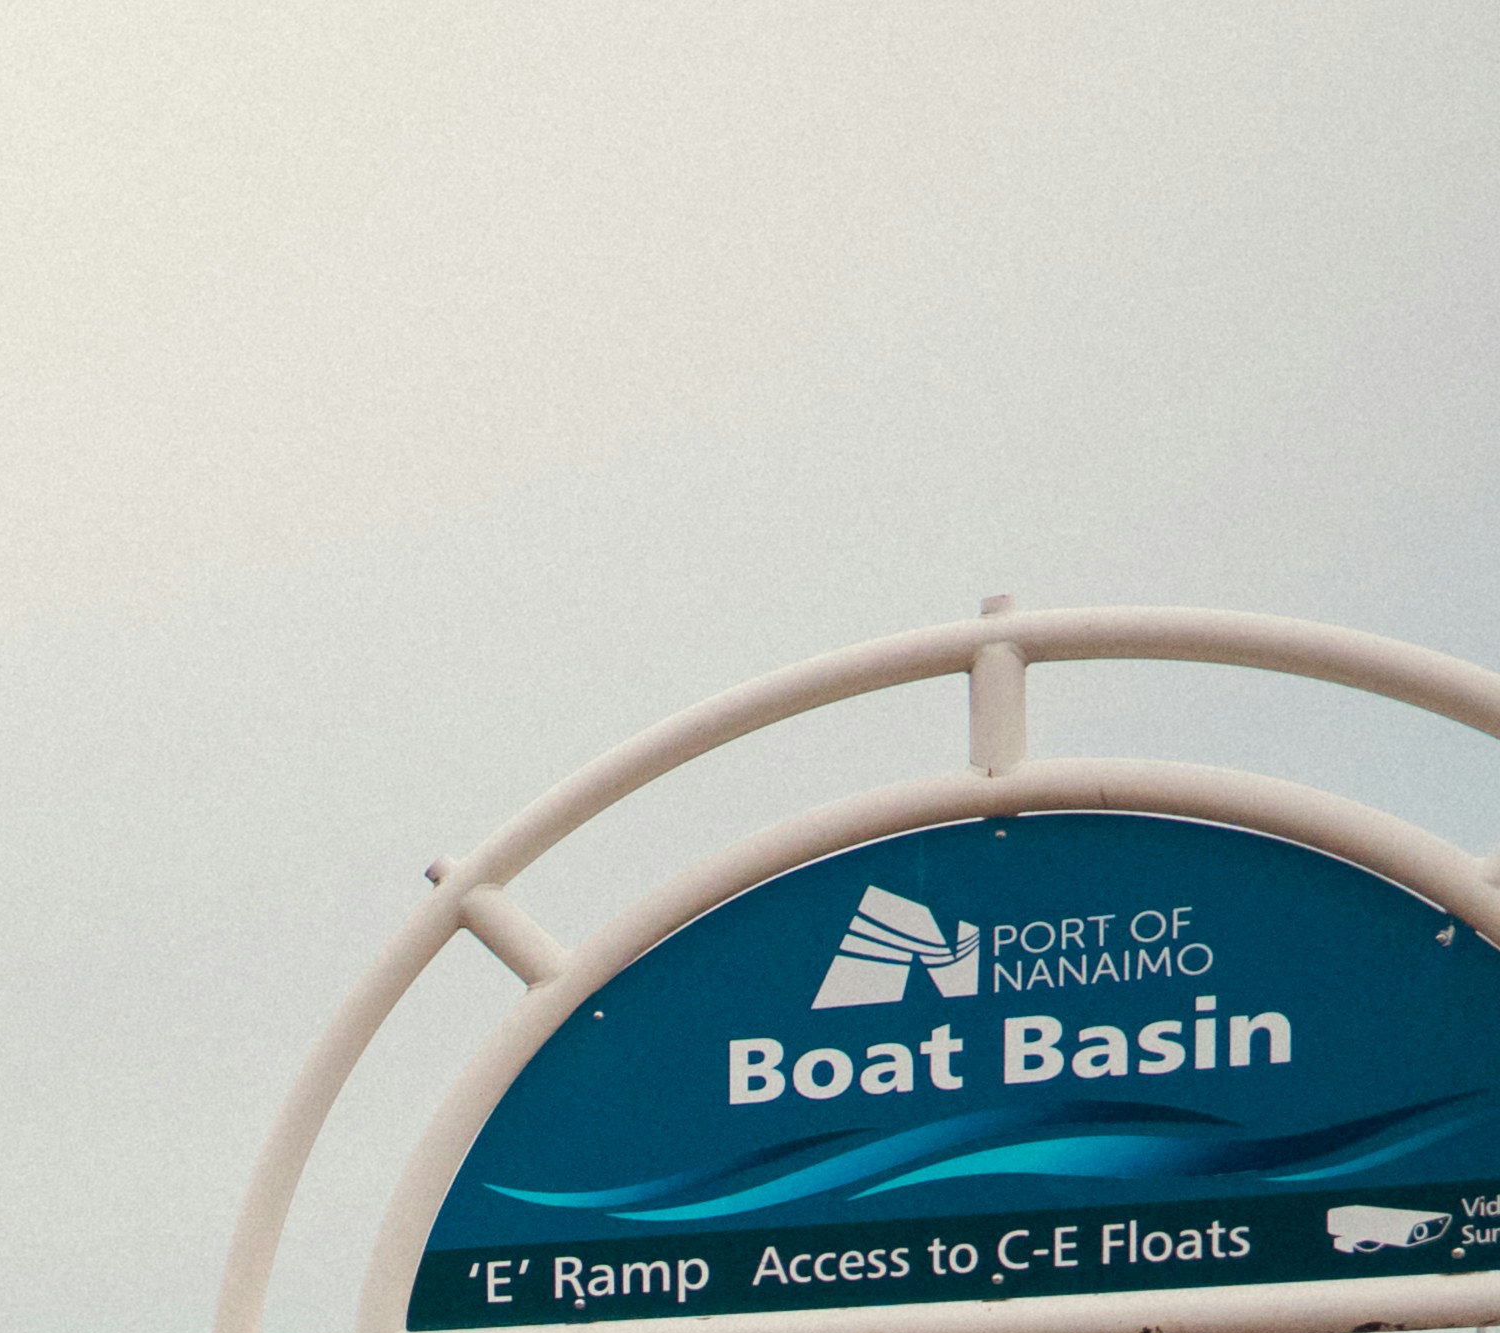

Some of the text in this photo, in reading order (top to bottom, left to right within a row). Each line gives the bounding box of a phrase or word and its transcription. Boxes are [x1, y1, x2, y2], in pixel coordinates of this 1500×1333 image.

[994, 906, 1192, 957] PORT OF
[994, 943, 1213, 993] NANAIMO
[729, 995, 1292, 1105] Boat Basin
[554, 1256, 710, 1304] Ramp
[752, 1244, 910, 1286] Access
[927, 1236, 979, 1275] to
[997, 1225, 1079, 1270] C-E
[1101, 1219, 1251, 1265] Floats
